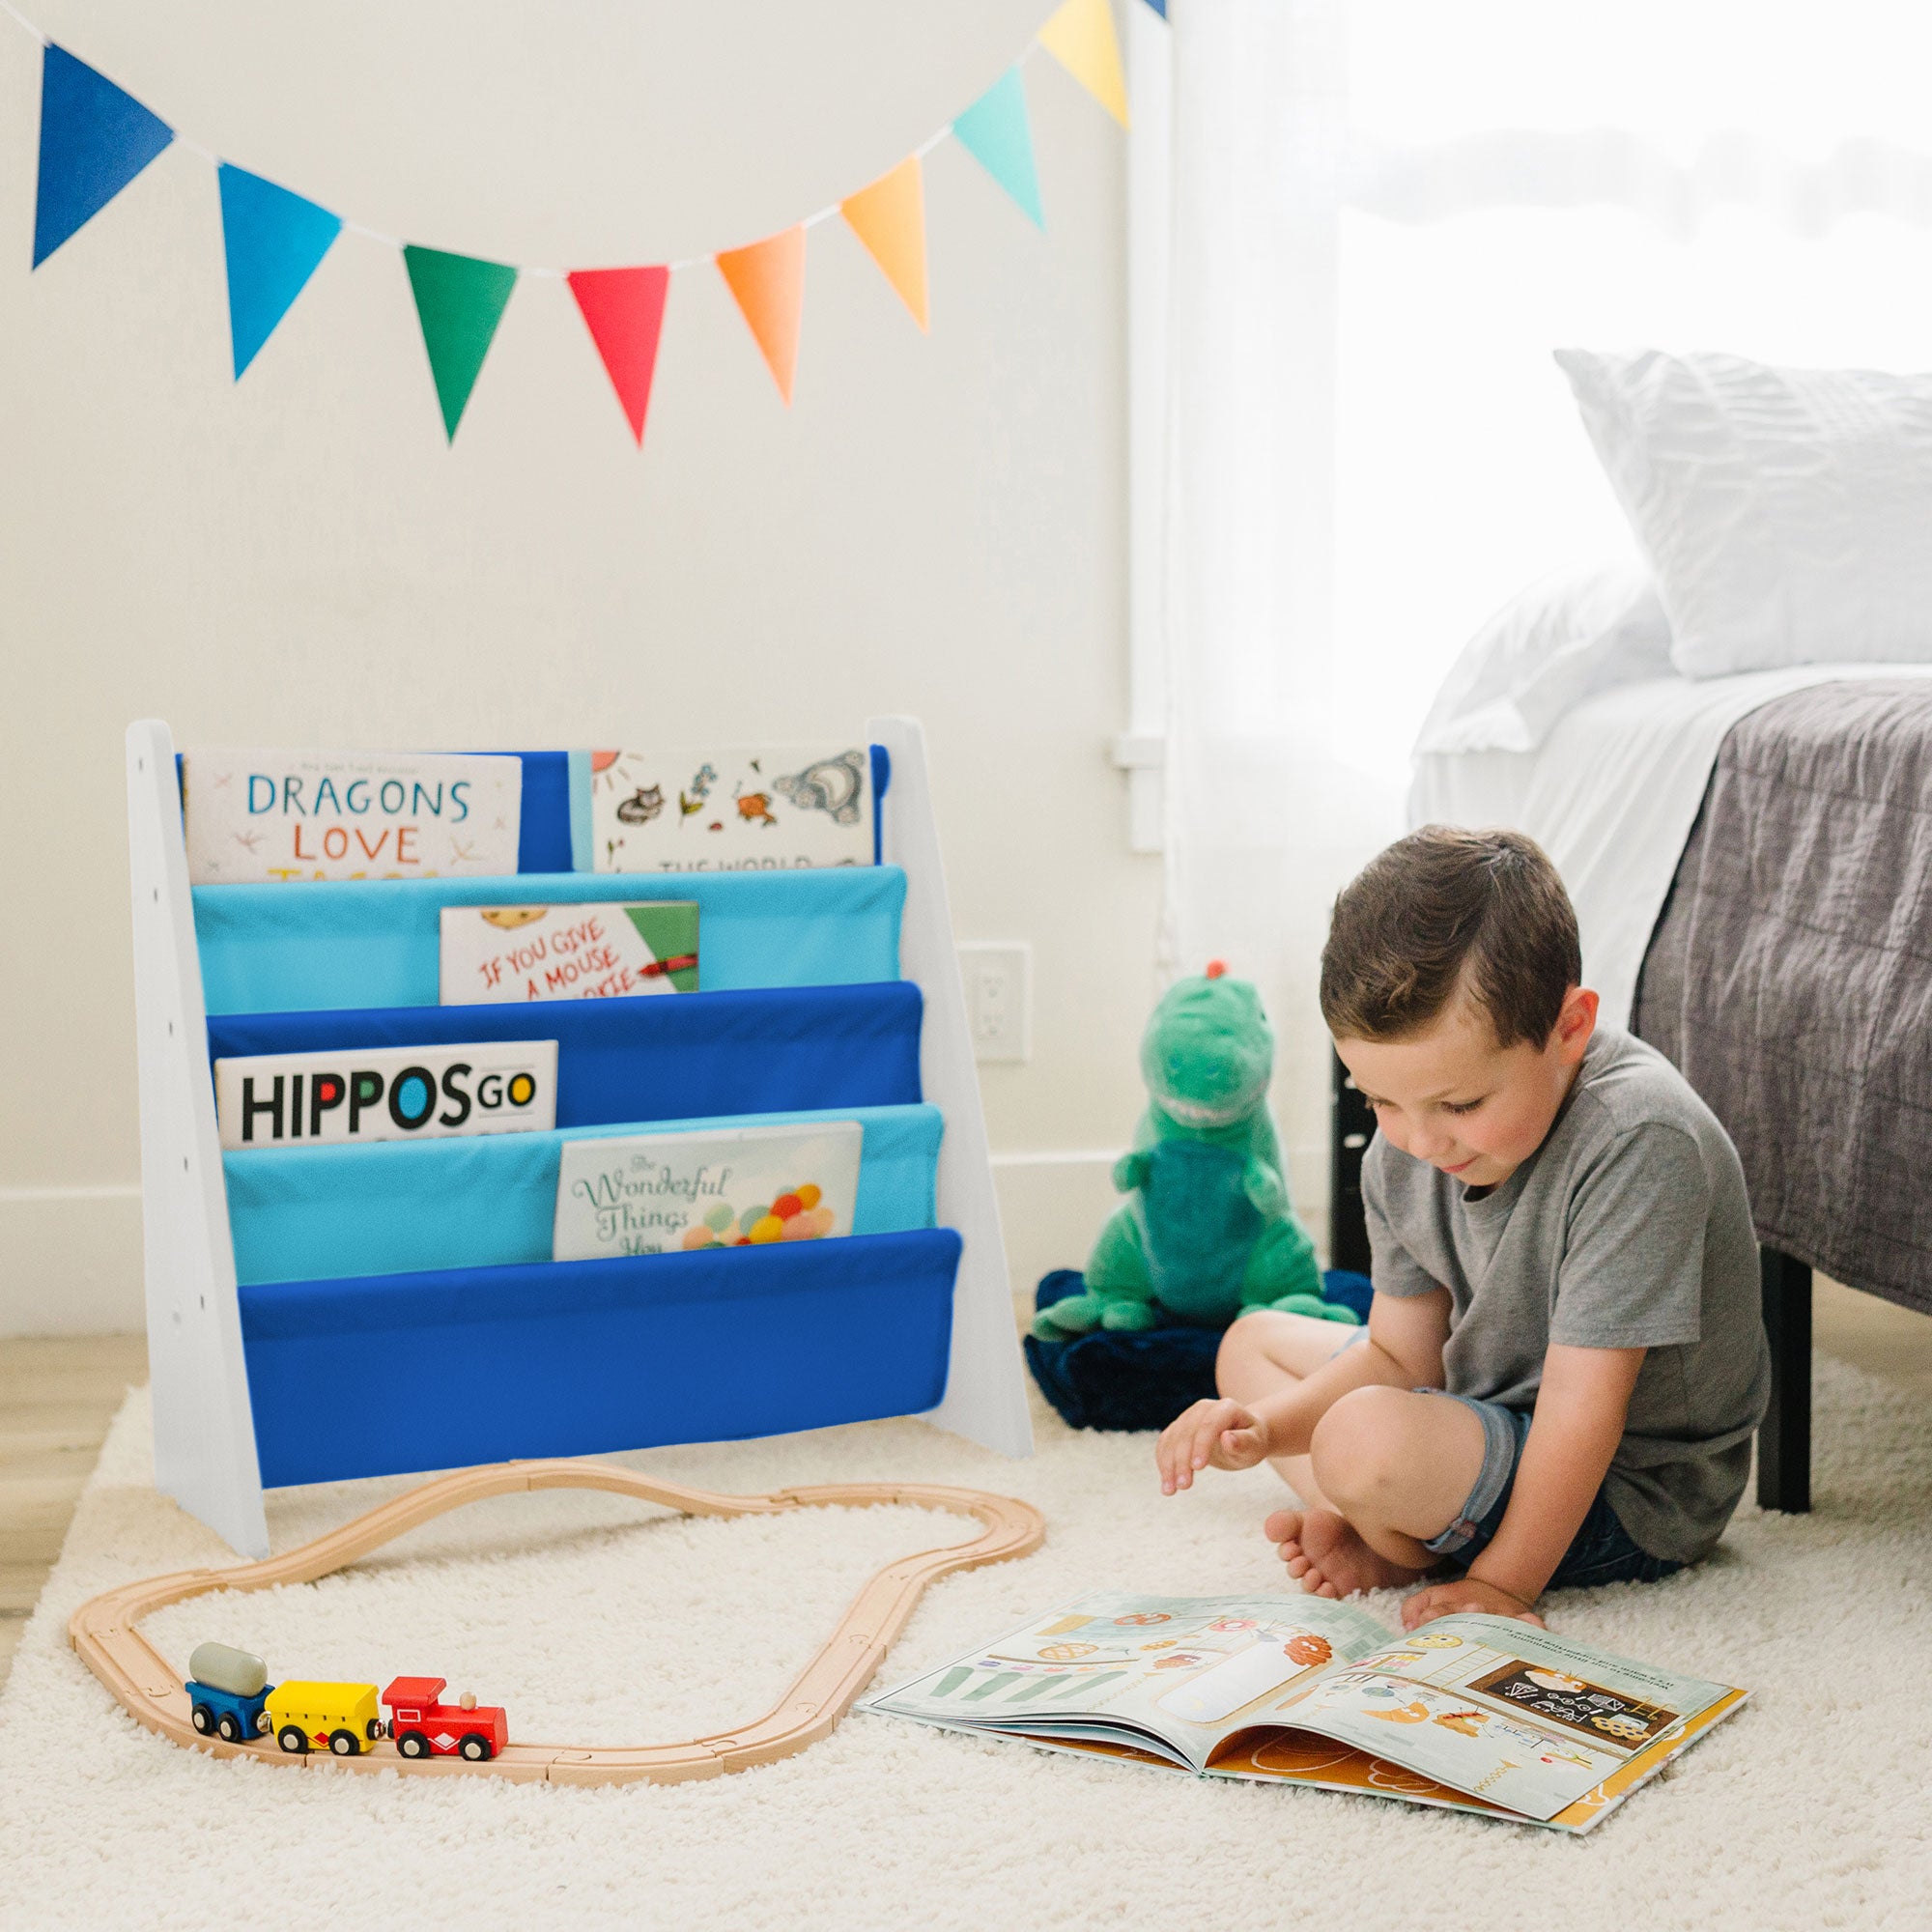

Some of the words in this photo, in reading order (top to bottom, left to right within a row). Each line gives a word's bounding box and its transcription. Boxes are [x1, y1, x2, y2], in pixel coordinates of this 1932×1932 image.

[247, 774, 471, 823] DRAGONS
[294, 822, 421, 865] LOVE
[480, 956, 501, 990] IF
[506, 936, 548, 975] YOU
[551, 917, 607, 954] GIVE
[527, 978, 541, 1001] A
[544, 944, 621, 992] MOUSE
[242, 1063, 473, 1142] HIPPOS
[477, 1072, 537, 1109] GO
[571, 1165, 732, 1208] Wonderful
[594, 1202, 689, 1243] Things
